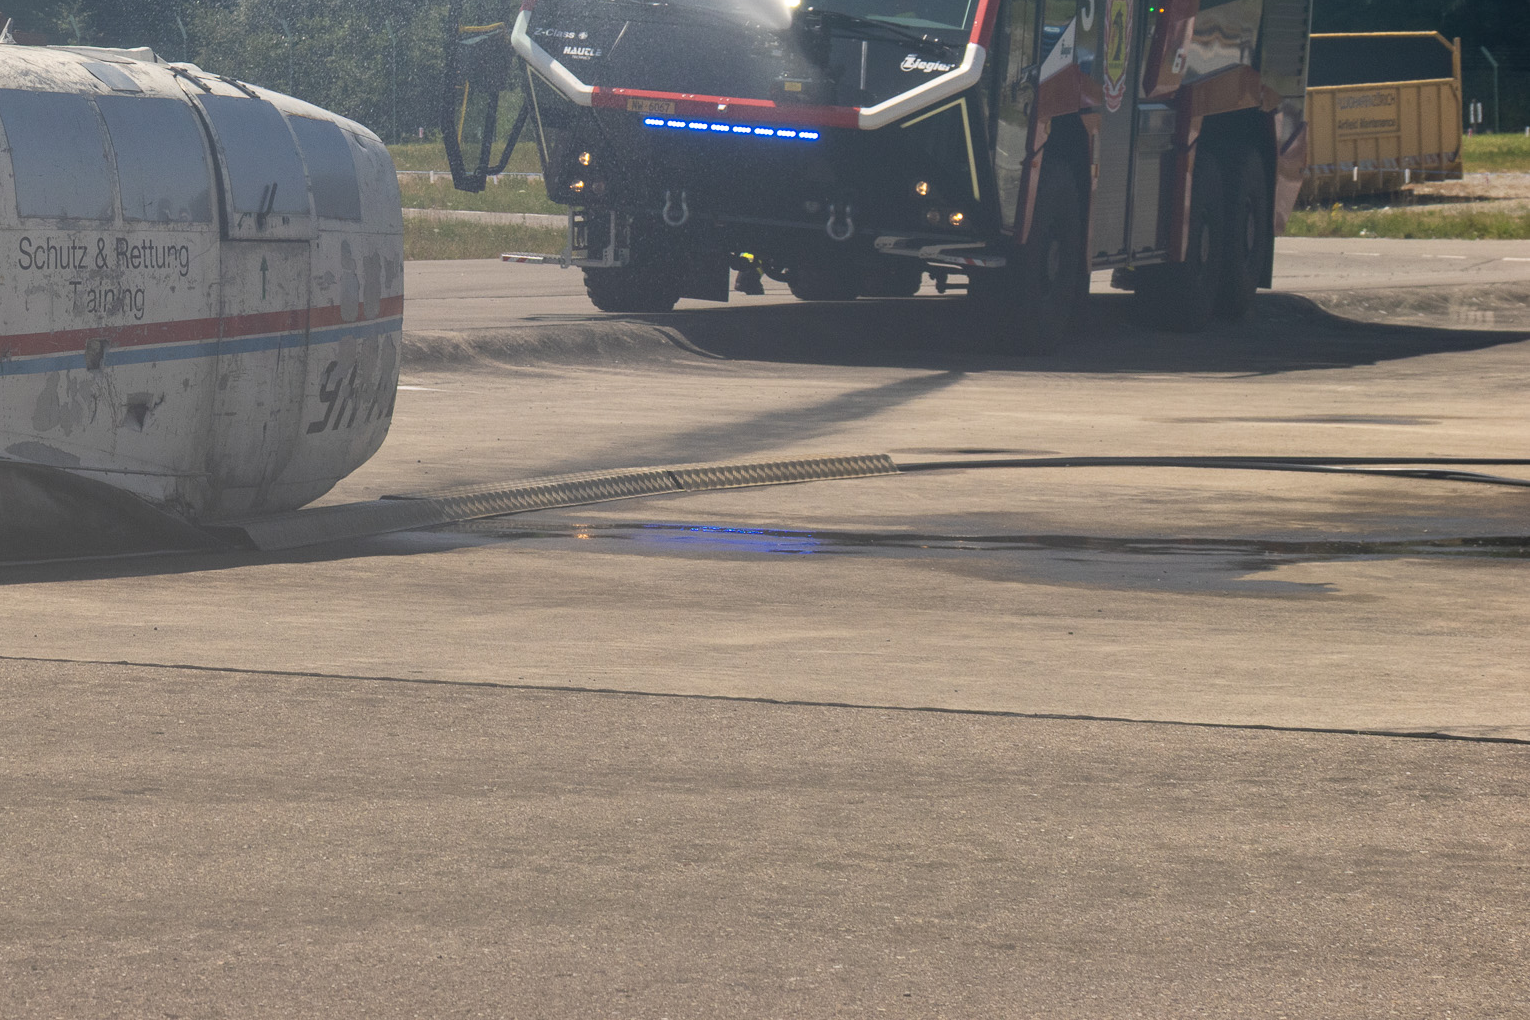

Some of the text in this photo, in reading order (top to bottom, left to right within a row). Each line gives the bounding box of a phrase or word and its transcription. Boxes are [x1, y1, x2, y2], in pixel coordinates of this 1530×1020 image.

[533, 27, 576, 39] Z-Class
[901, 54, 955, 73] Ziegler
[19, 236, 190, 277] Schutz & Rettung
